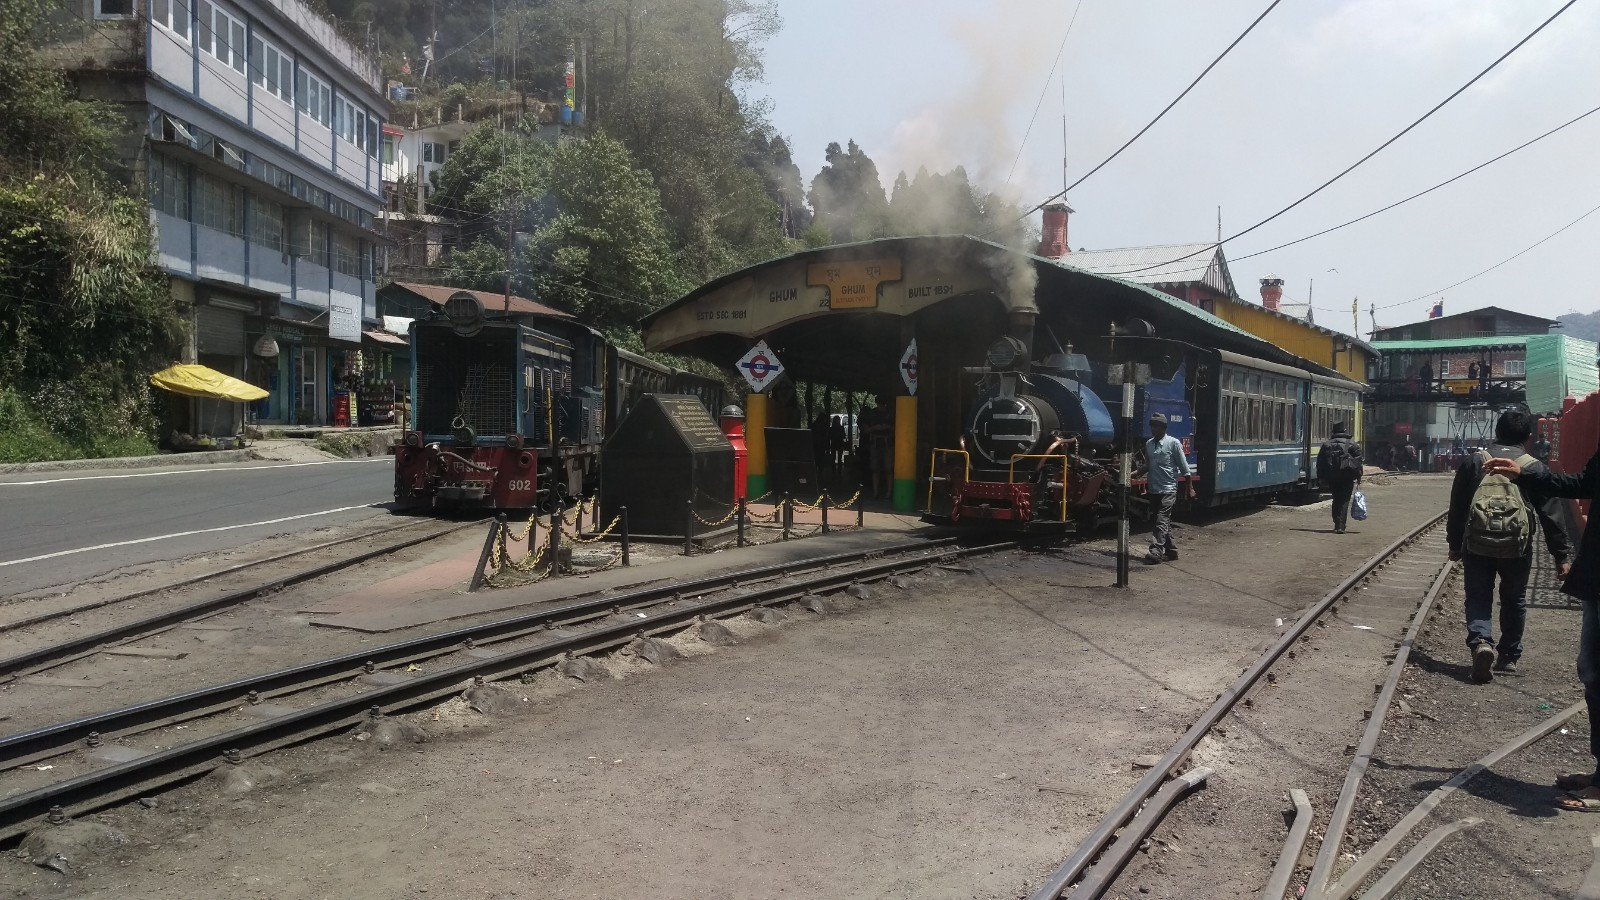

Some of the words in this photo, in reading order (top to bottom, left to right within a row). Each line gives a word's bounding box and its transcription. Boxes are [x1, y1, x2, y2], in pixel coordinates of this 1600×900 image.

[769, 287, 798, 303] GHUM
[841, 284, 866, 295] GHUM
[908, 286, 931, 299] BUILT
[508, 479, 531, 492] 602
